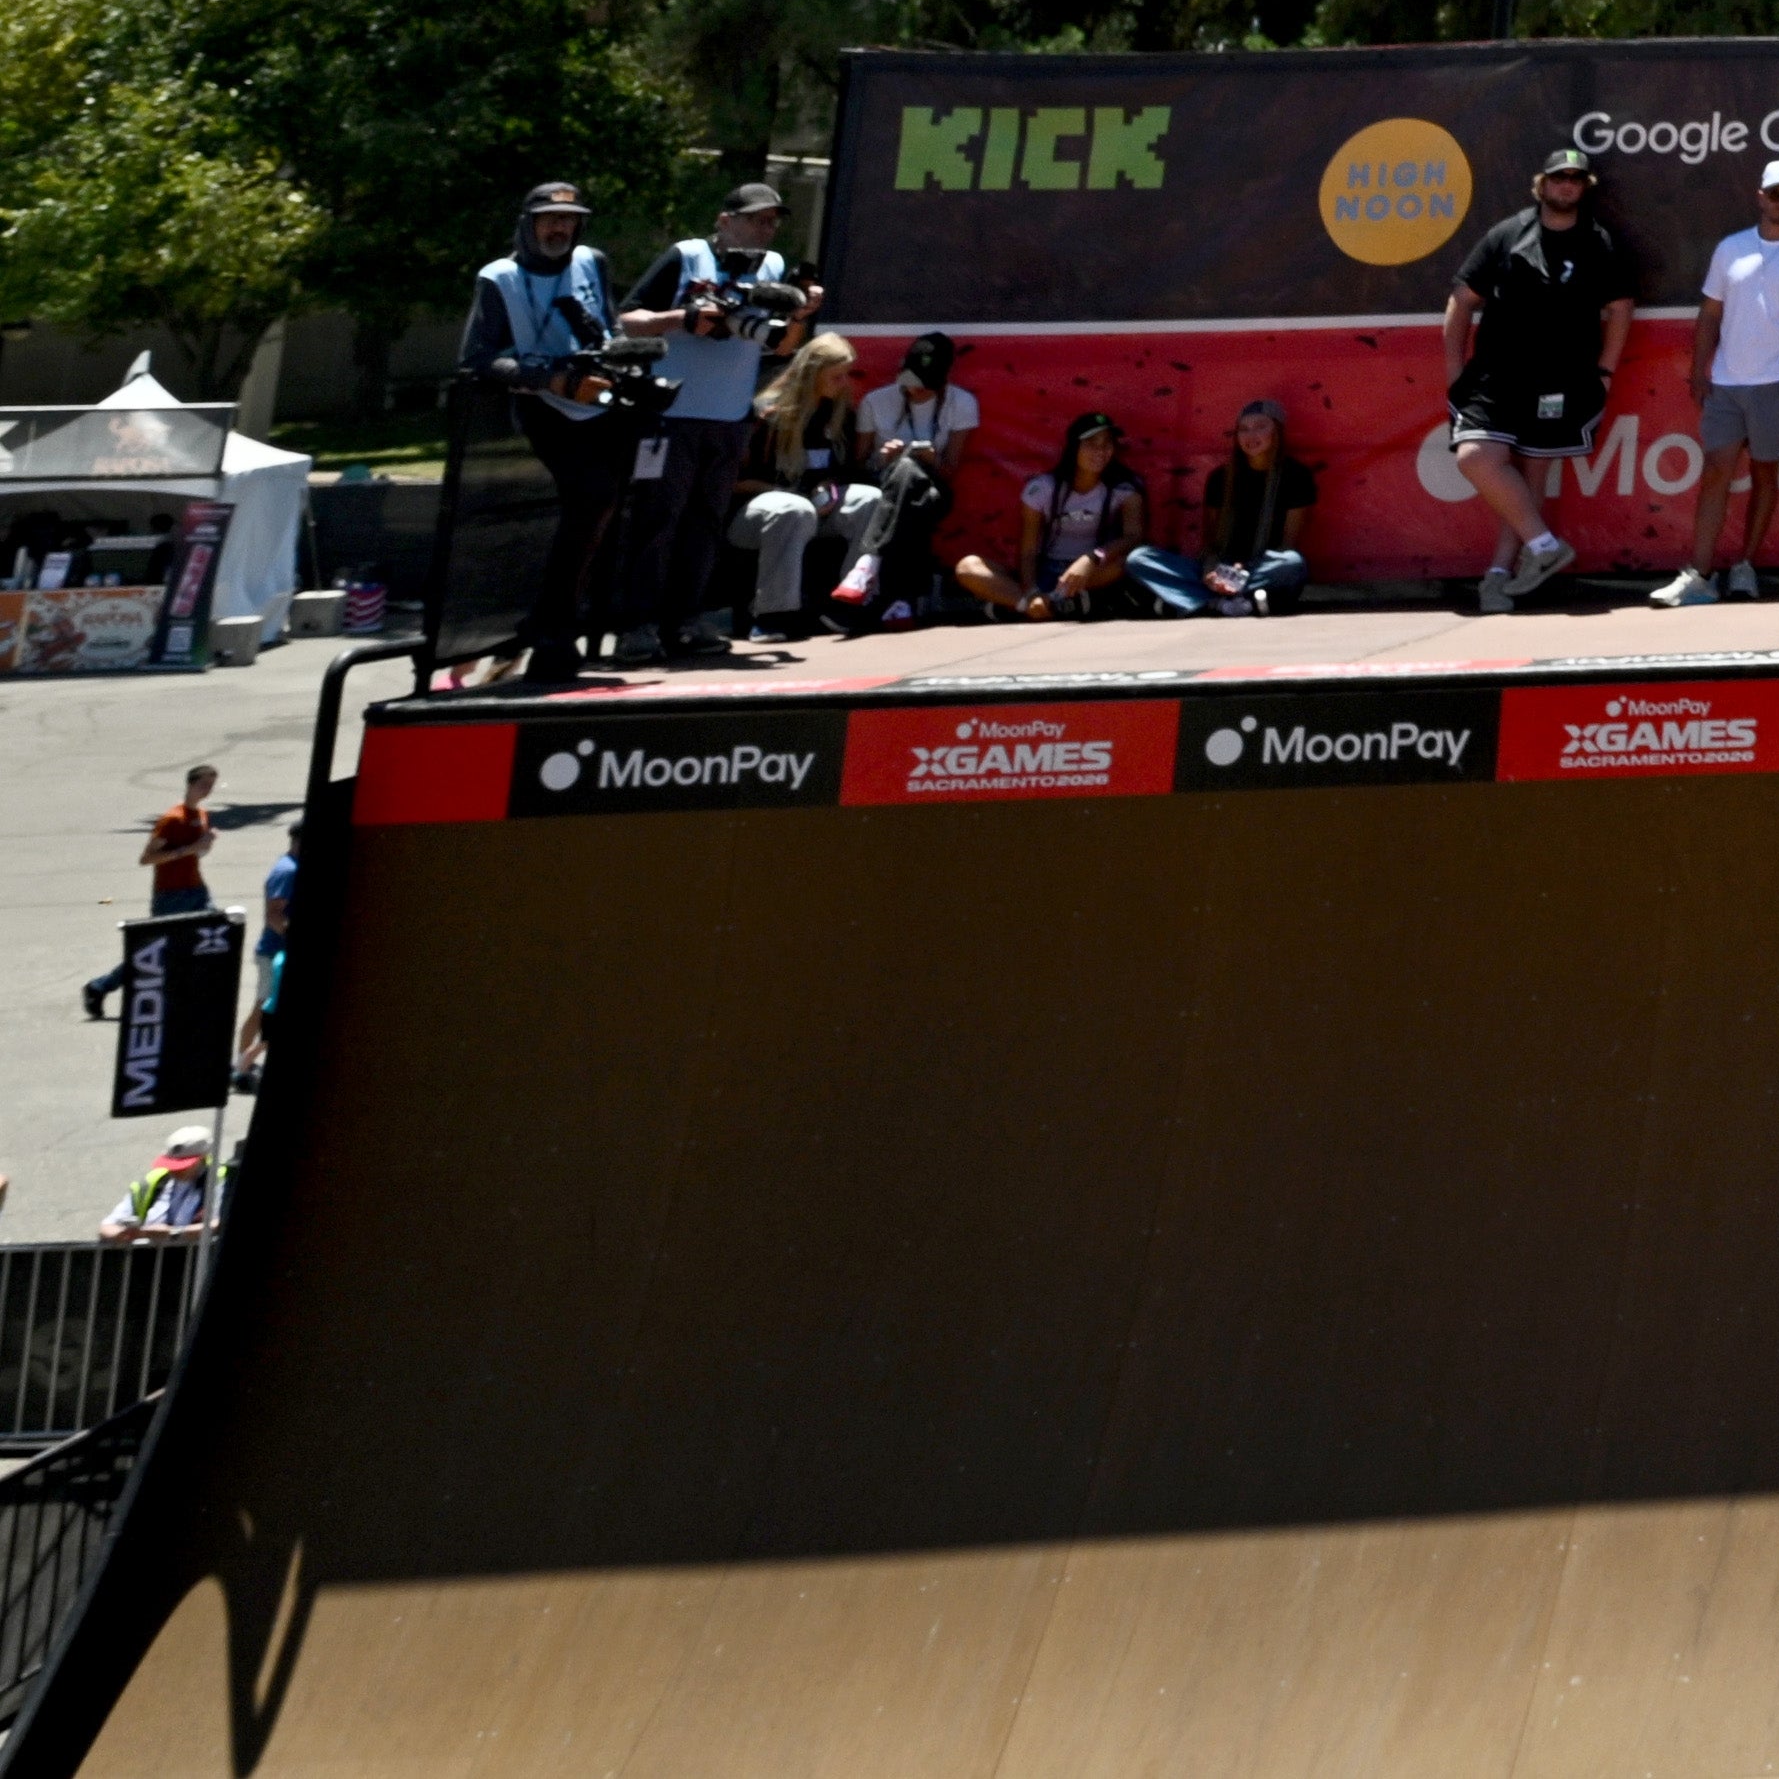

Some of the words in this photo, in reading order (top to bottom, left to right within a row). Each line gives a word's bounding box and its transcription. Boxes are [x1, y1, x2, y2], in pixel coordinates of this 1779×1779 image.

[896, 105, 1173, 192] KICK
[1573, 111, 1749, 165] Google
[1346, 159, 1447, 190] HIGH
[1335, 192, 1455, 221] NOON
[979, 720, 1066, 739] MoonPay
[1628, 698, 1711, 717] MoonPay
[597, 740, 816, 792] MoonPay
[1263, 715, 1472, 768] MoonPay
[122, 936, 168, 1108] MEDIA
